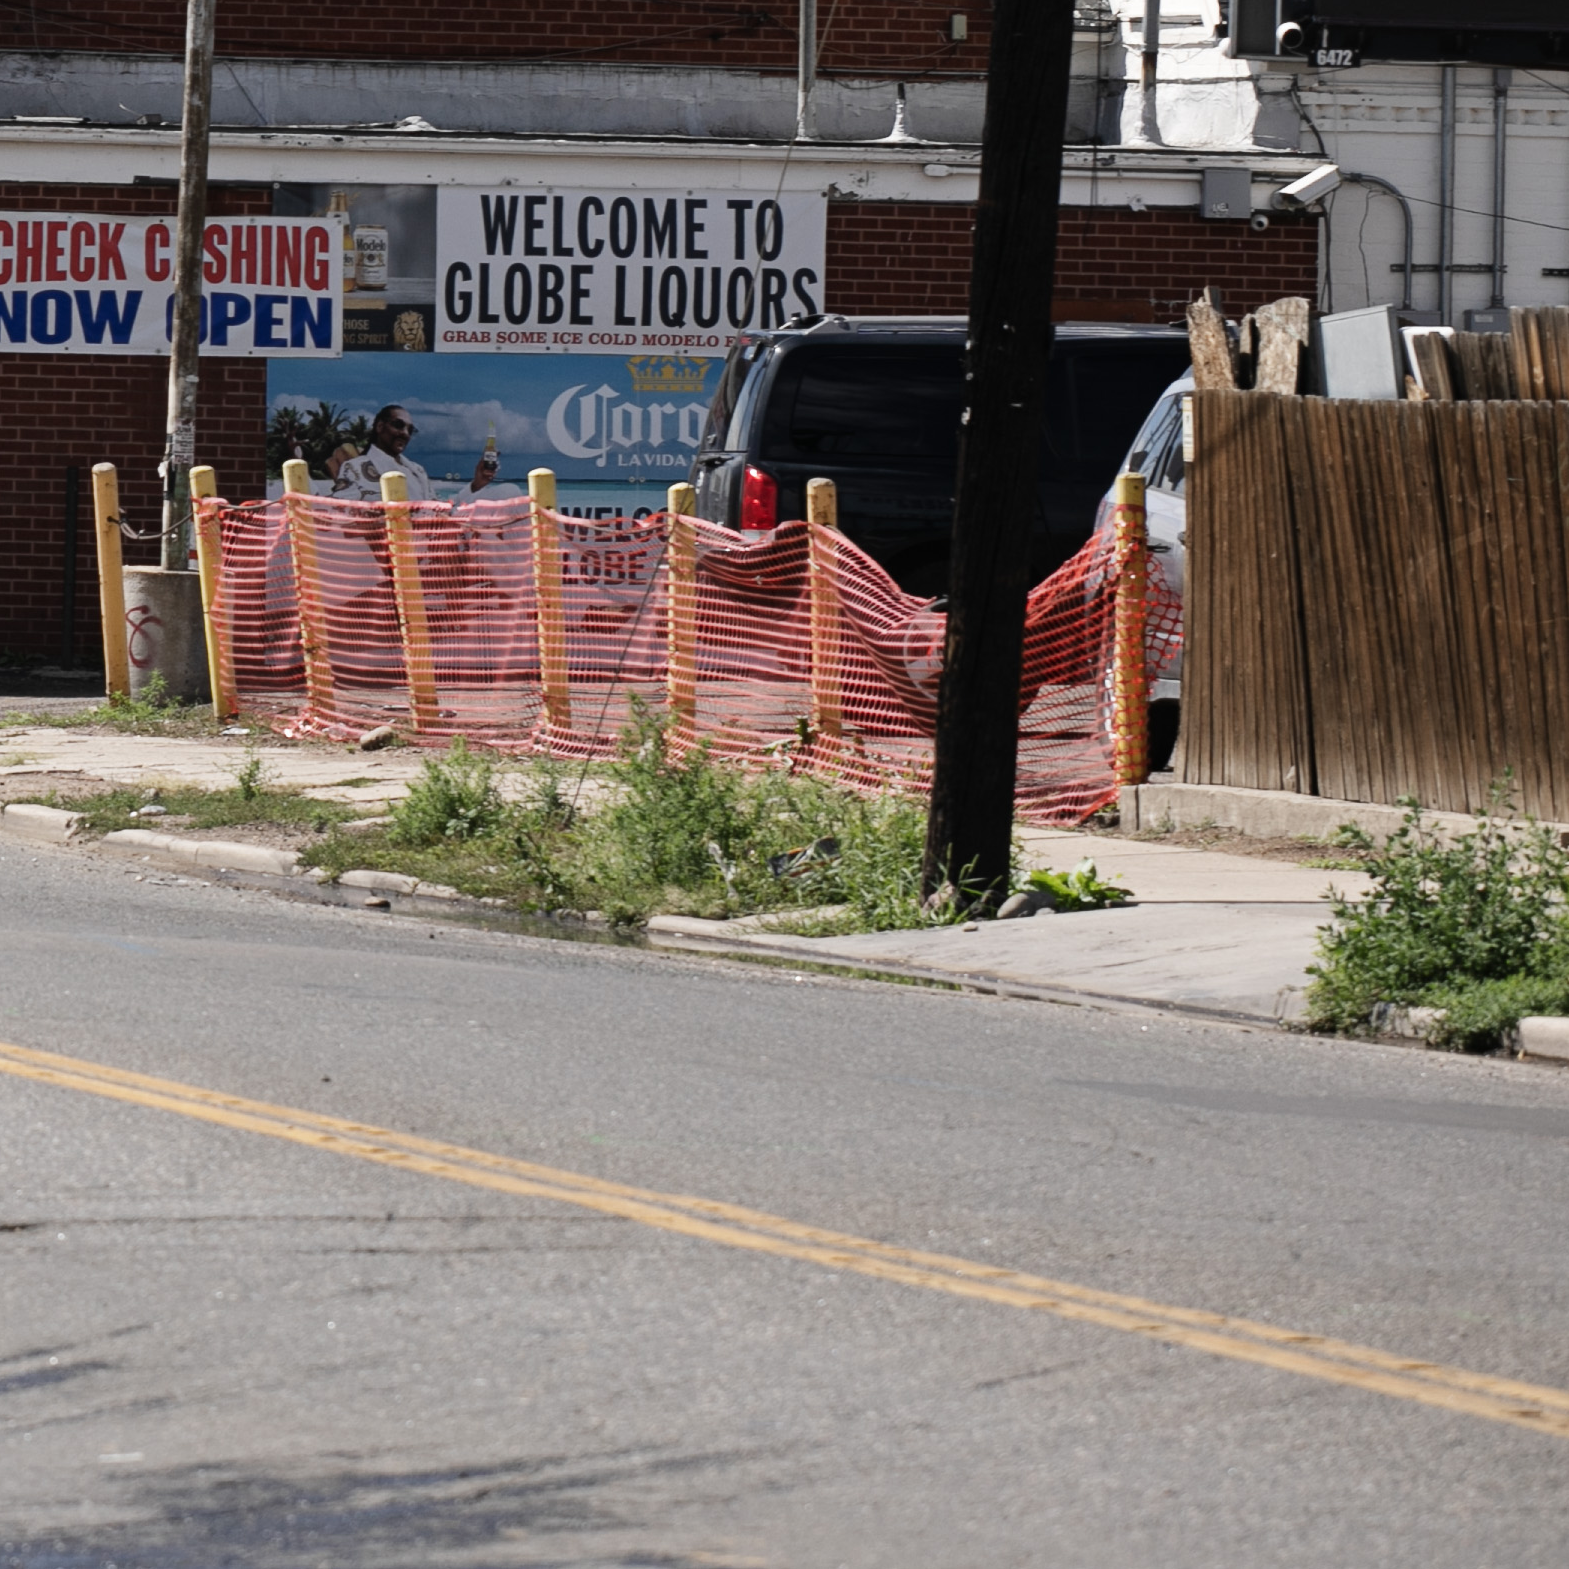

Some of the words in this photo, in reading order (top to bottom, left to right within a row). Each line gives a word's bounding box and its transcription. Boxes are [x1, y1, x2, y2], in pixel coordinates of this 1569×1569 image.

[1317, 50, 1352, 66] 6472
[480, 195, 708, 259] WELCOME
[726, 198, 784, 262] TO
[144, 223, 331, 291] CSHING
[444, 261, 595, 326] GLOBE
[613, 265, 819, 330] LIQUORS
[343, 318, 370, 330] HOSE
[442, 330, 491, 344] GRAB
[496, 331, 547, 345] SOME
[552, 332, 583, 345] ICE
[588, 333, 637, 346] COLD
[642, 334, 719, 347] MODELO
[546, 383, 710, 467] Coro
[618, 454, 641, 466] LA
[644, 454, 687, 467] VIDA
[561, 550, 647, 585] LOBE
